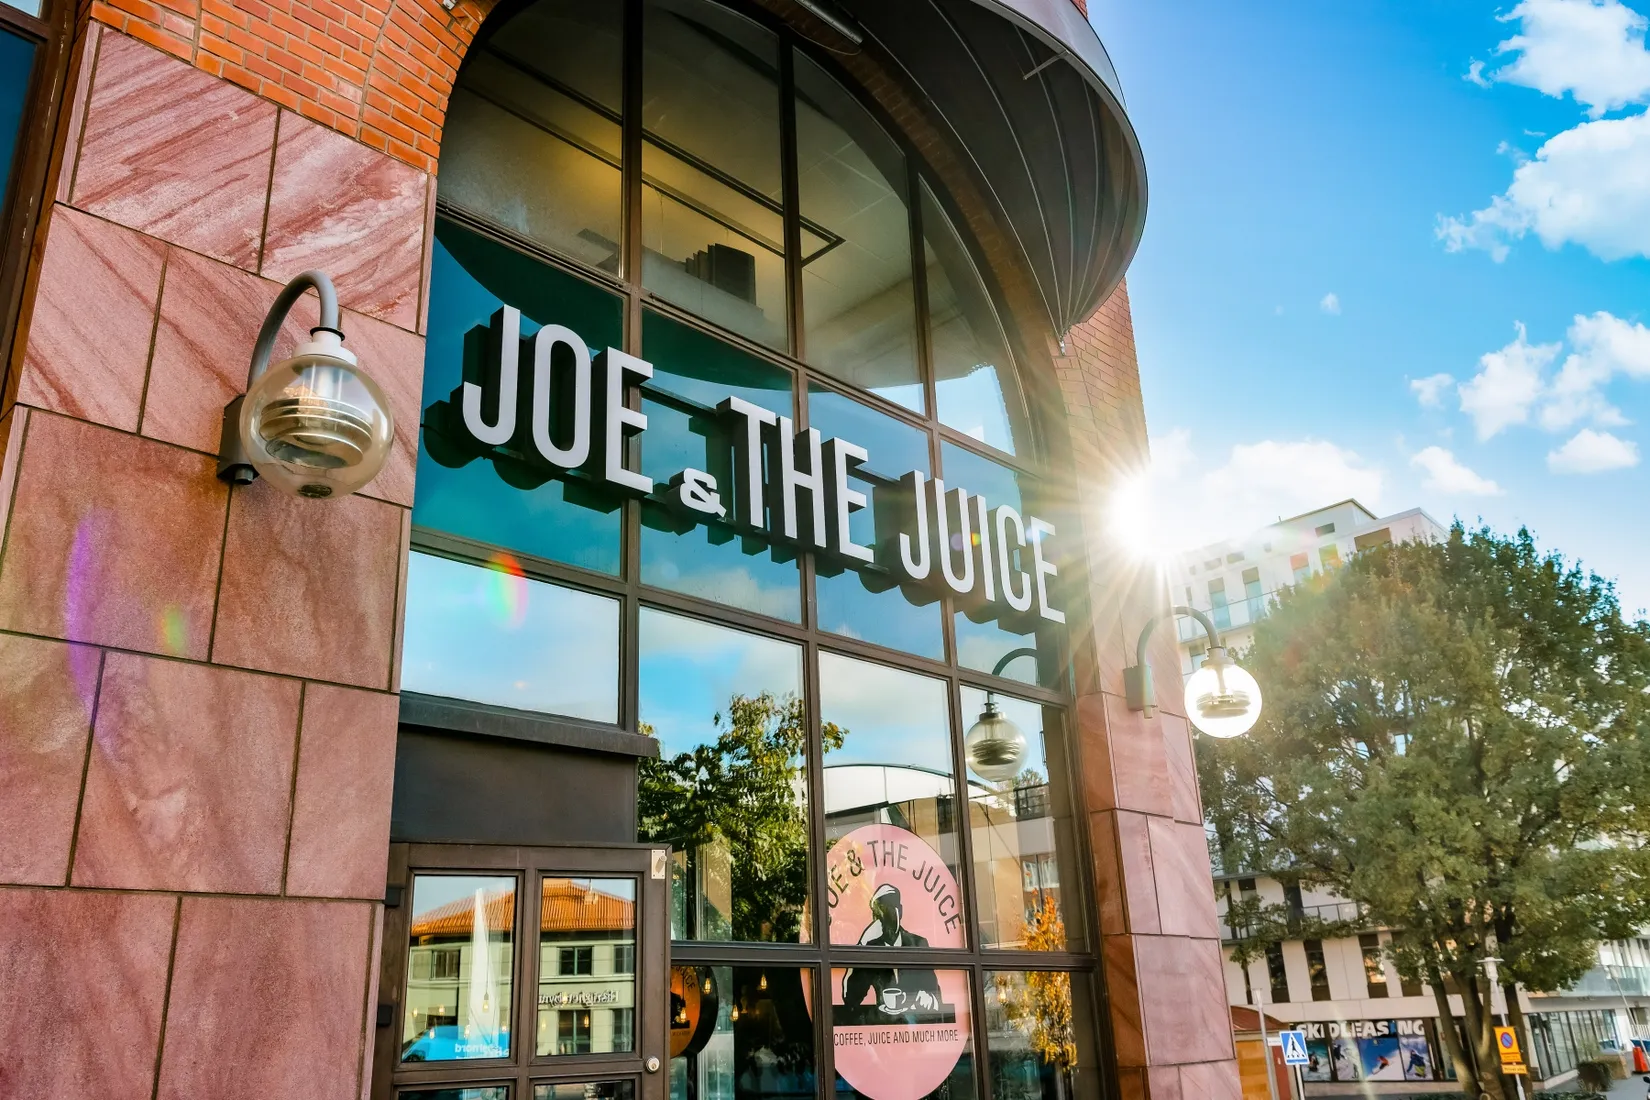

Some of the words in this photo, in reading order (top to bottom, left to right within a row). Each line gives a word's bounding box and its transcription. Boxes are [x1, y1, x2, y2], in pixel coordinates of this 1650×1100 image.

[462, 304, 654, 494] JOE
[679, 467, 726, 518] &
[729, 396, 875, 564] THE
[900, 470, 1067, 625] JUICE
[847, 849, 866, 877] &
[867, 840, 909, 872] THE
[912, 860, 962, 935] JUICE
[833, 1032, 866, 1047] COFFEE,
[868, 1031, 891, 1045] JUICE
[893, 1030, 911, 1044] AND
[912, 1029, 935, 1043] MUCH
[937, 1029, 959, 1042] MORE
